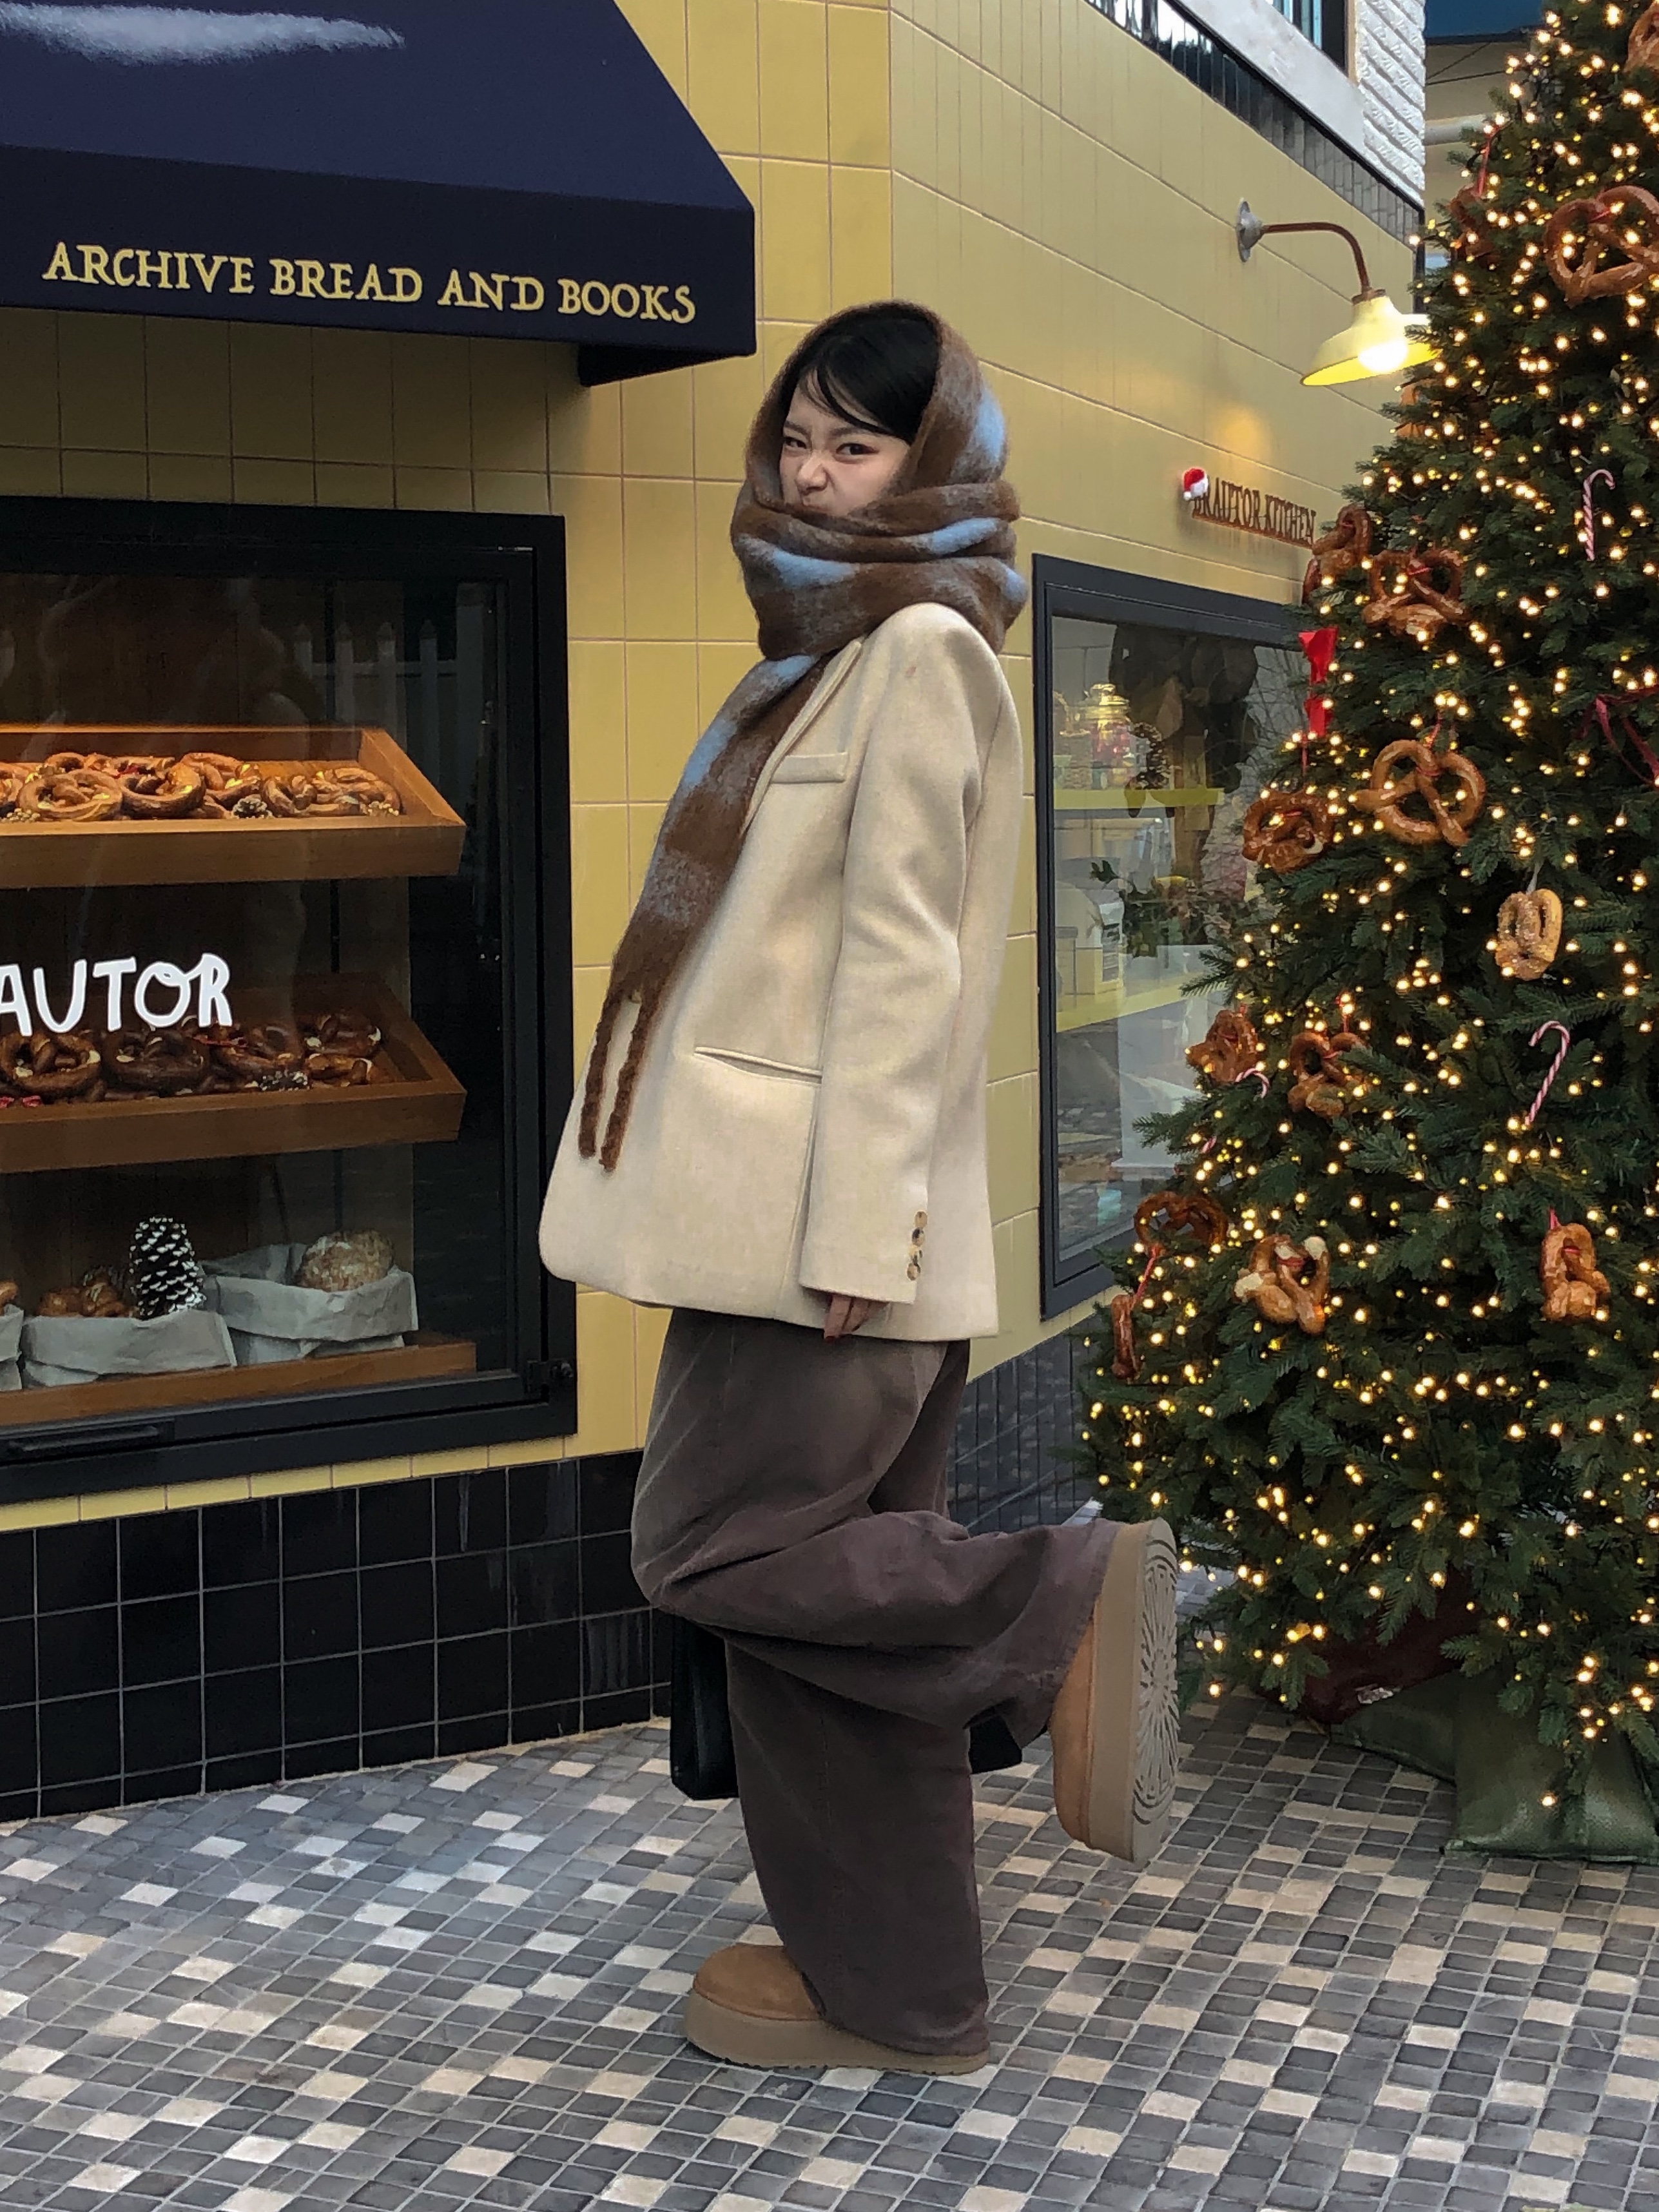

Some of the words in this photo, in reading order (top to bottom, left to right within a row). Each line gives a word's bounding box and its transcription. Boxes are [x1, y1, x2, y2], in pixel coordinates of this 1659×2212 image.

[42, 242, 254, 295] ARCHIVE
[269, 259, 422, 302] BREAD
[438, 269, 544, 312] AND
[558, 279, 695, 323] BOOKS
[1264, 494, 1317, 547] KITCHEN
[0, 953, 233, 1036] AUTOR
